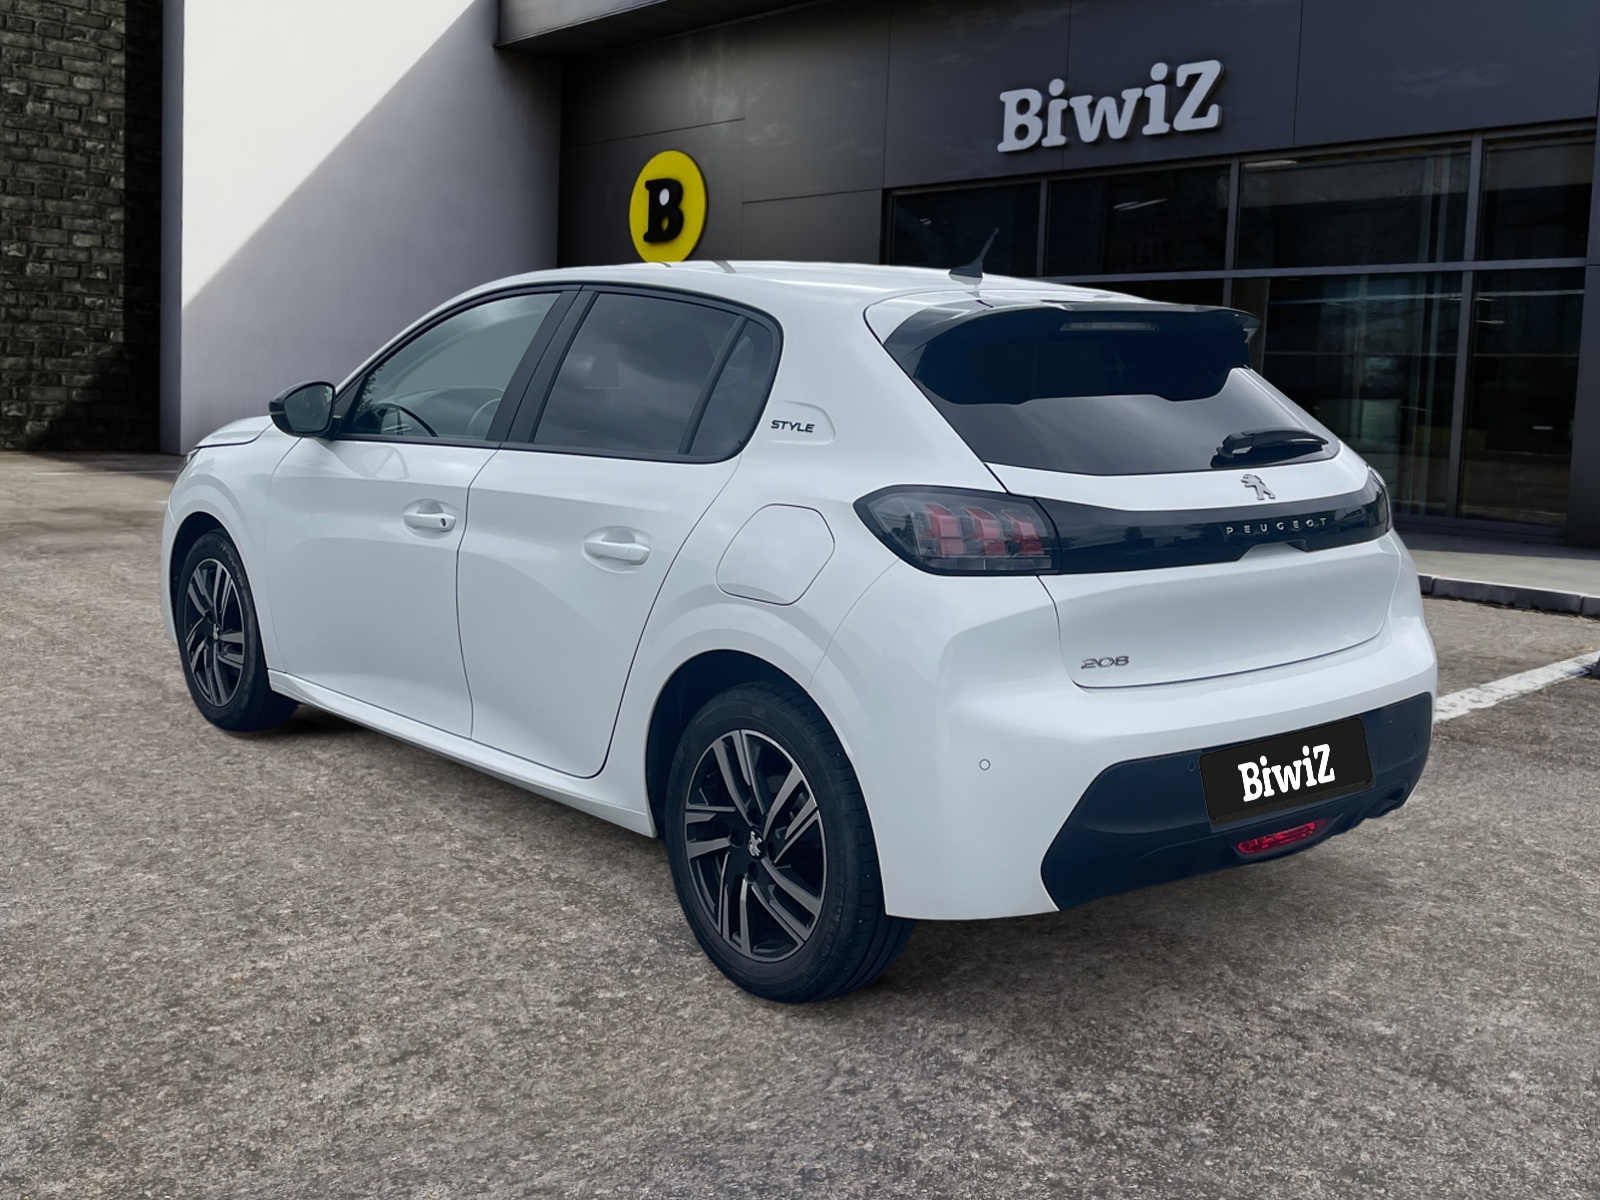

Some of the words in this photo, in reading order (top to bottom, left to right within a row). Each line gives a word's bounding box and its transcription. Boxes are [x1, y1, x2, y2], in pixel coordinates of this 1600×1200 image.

[997, 59, 1222, 152] BiwiZ
[643, 178, 684, 243] B
[770, 419, 816, 433] STYLE
[1226, 517, 1326, 535] PEUGEOT
[1080, 655, 1130, 669] 208
[1237, 743, 1336, 802] BiwiZ
